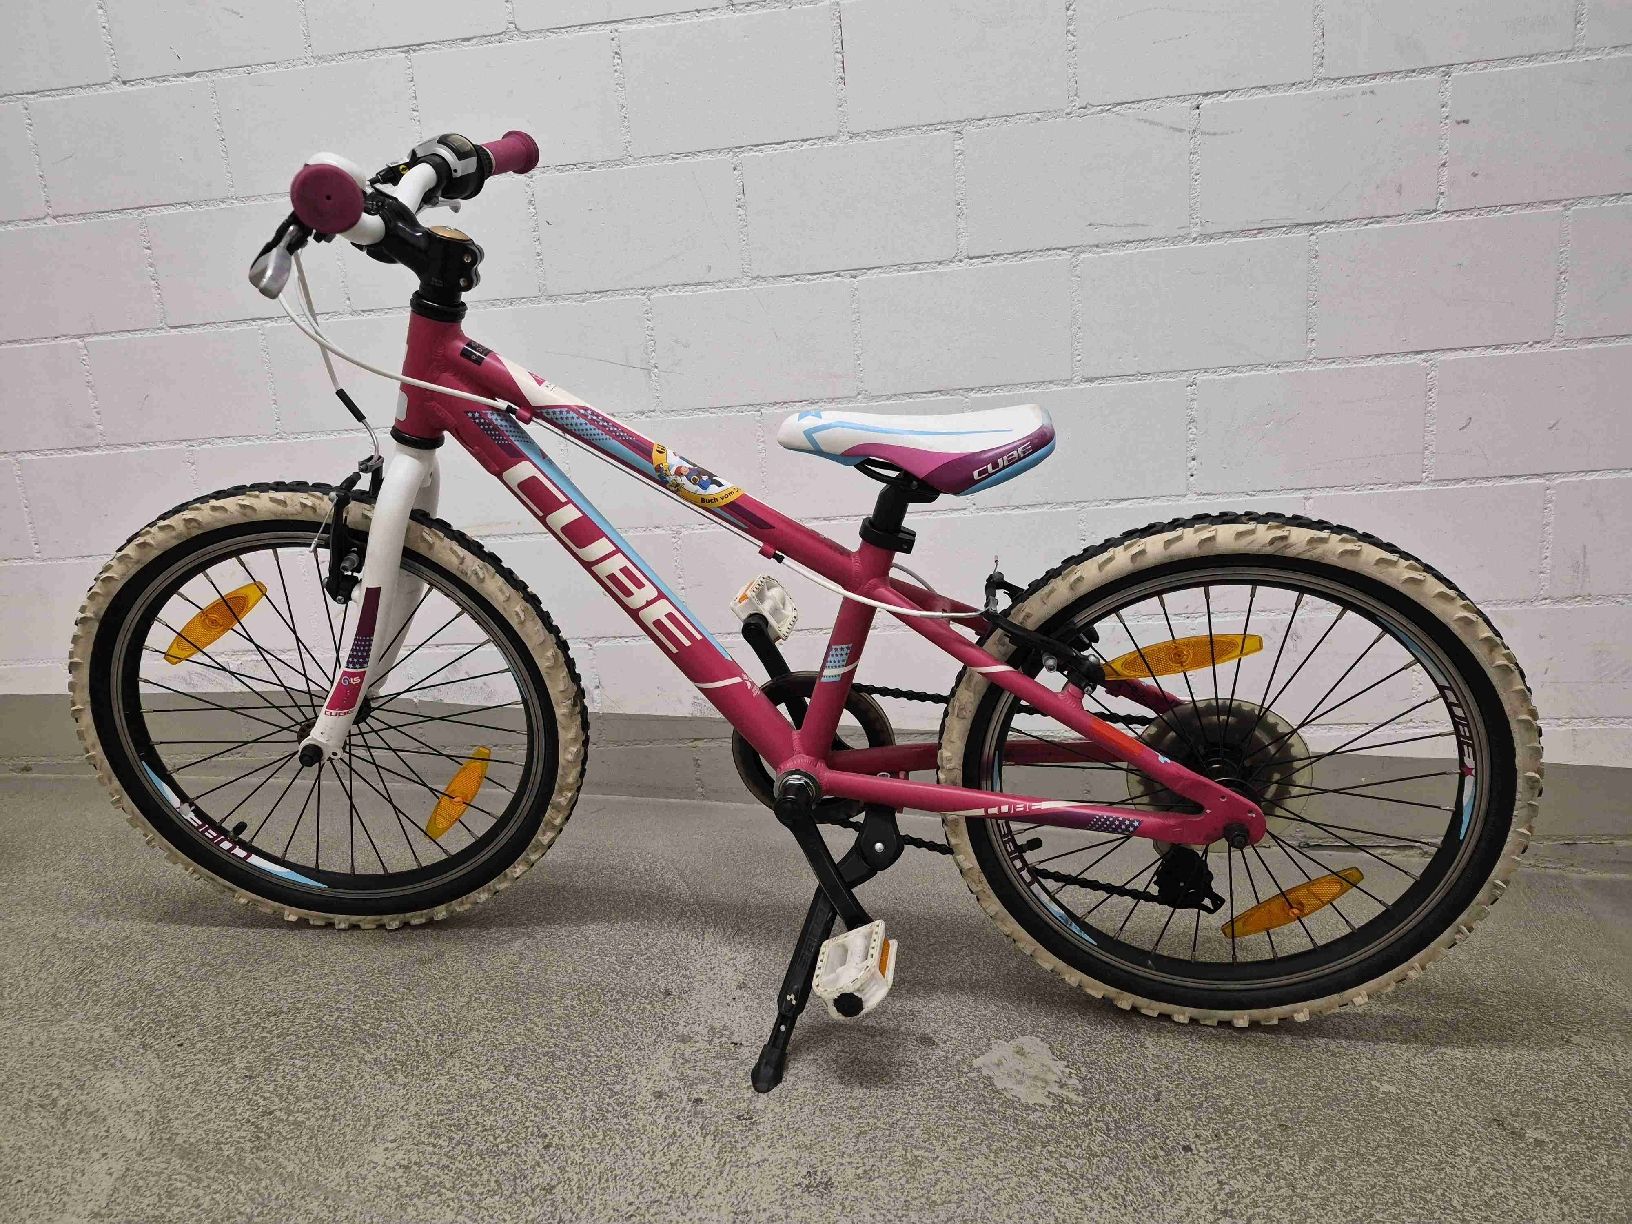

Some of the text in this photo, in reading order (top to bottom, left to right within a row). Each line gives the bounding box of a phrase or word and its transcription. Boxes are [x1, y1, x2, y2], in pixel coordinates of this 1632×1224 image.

[972, 441, 1033, 481] CUBE
[700, 496, 719, 504] Buch
[502, 460, 703, 654] CUBE
[984, 802, 1042, 817] CUBE
